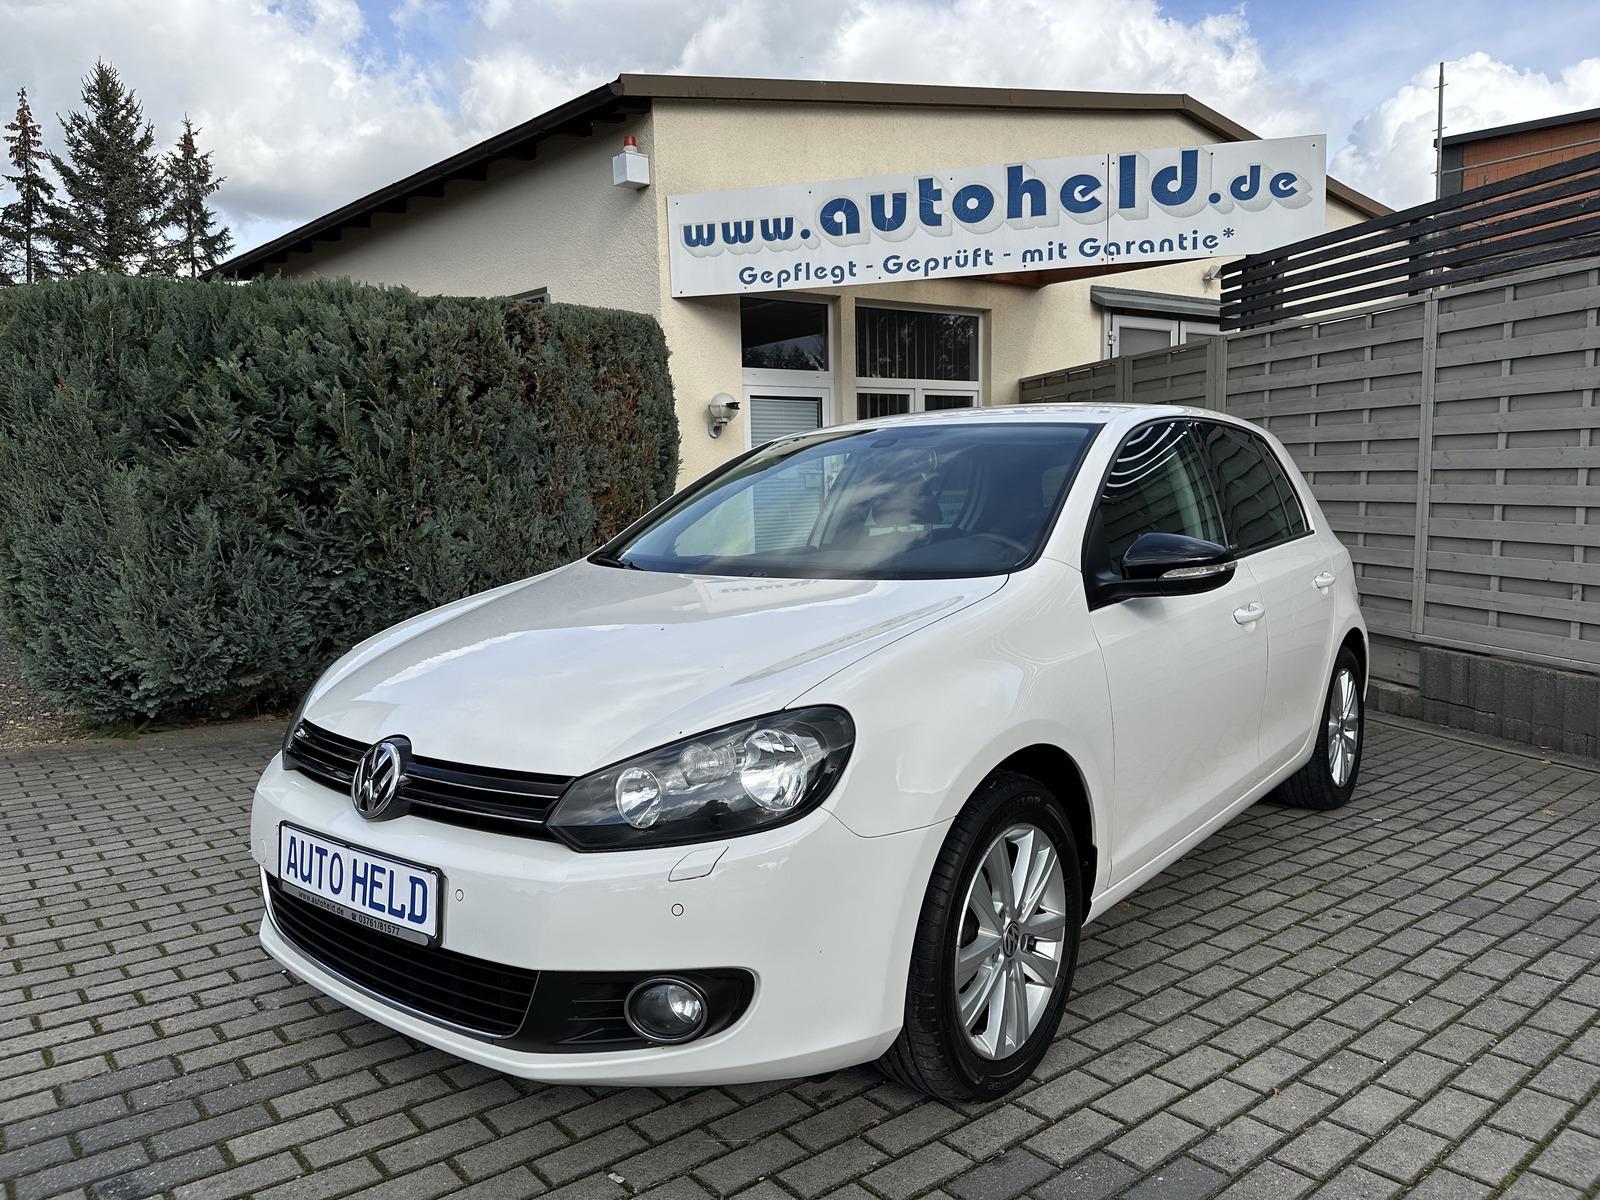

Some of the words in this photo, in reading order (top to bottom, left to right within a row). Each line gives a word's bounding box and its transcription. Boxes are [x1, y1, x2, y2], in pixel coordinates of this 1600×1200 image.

[682, 149, 1299, 248] www.autoheld.de
[738, 260, 857, 288] Gepflegt
[882, 247, 994, 277] Geprüft
[1021, 240, 1068, 263] mit
[286, 835, 344, 895] AUTO
[350, 858, 428, 925] HELD
[298, 891, 345, 916] www.autoheld.de
[358, 914, 400, 936] 03761/81577
